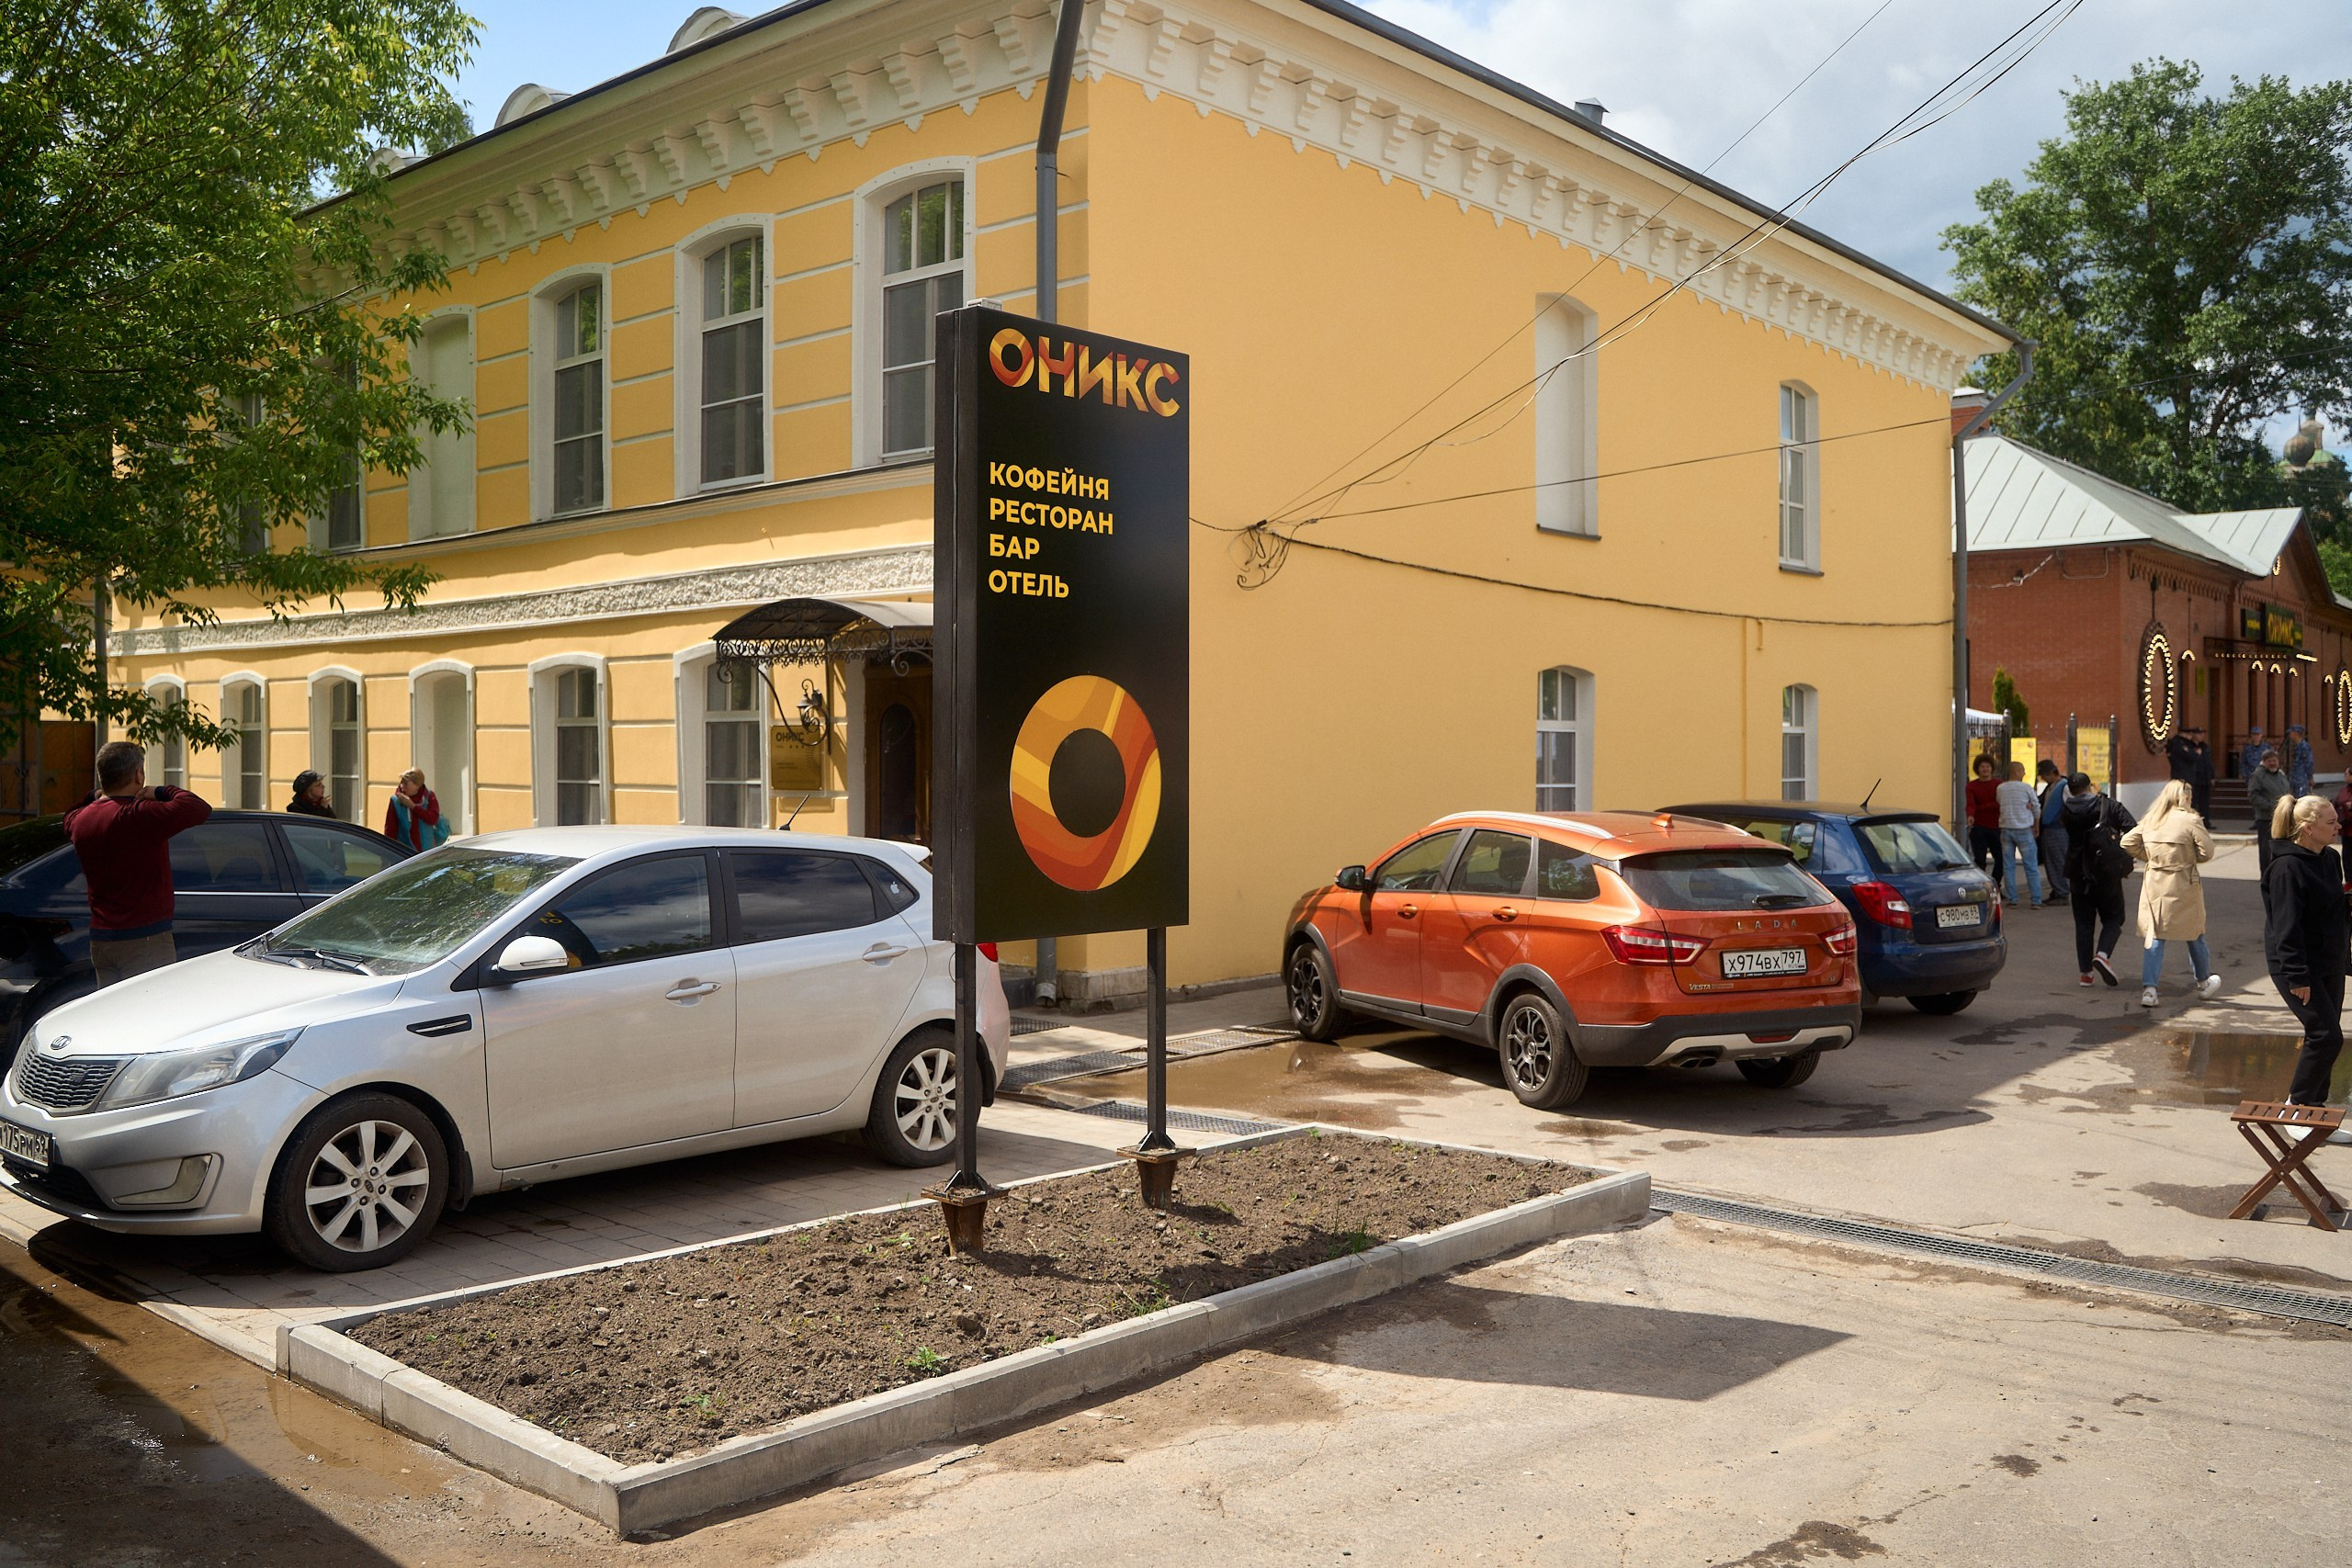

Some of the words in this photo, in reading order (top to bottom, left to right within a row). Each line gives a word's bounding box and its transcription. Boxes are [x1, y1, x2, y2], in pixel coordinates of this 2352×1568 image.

[989, 328, 1181, 417] ОНИКС
[989, 461, 1109, 501] КОФЕЙНЯ
[989, 497, 1114, 535] РЕСТОРАН
[989, 534, 1040, 560] БАР
[988, 570, 1069, 598] ОТЕЛЬ
[1736, 919, 1797, 931] LADA
[1728, 953, 1781, 972] Х974ВХ
[1781, 951, 1802, 964] 797
[1689, 983, 1712, 991] VESTA
[0, 1122, 33, 1158] 175РМ
